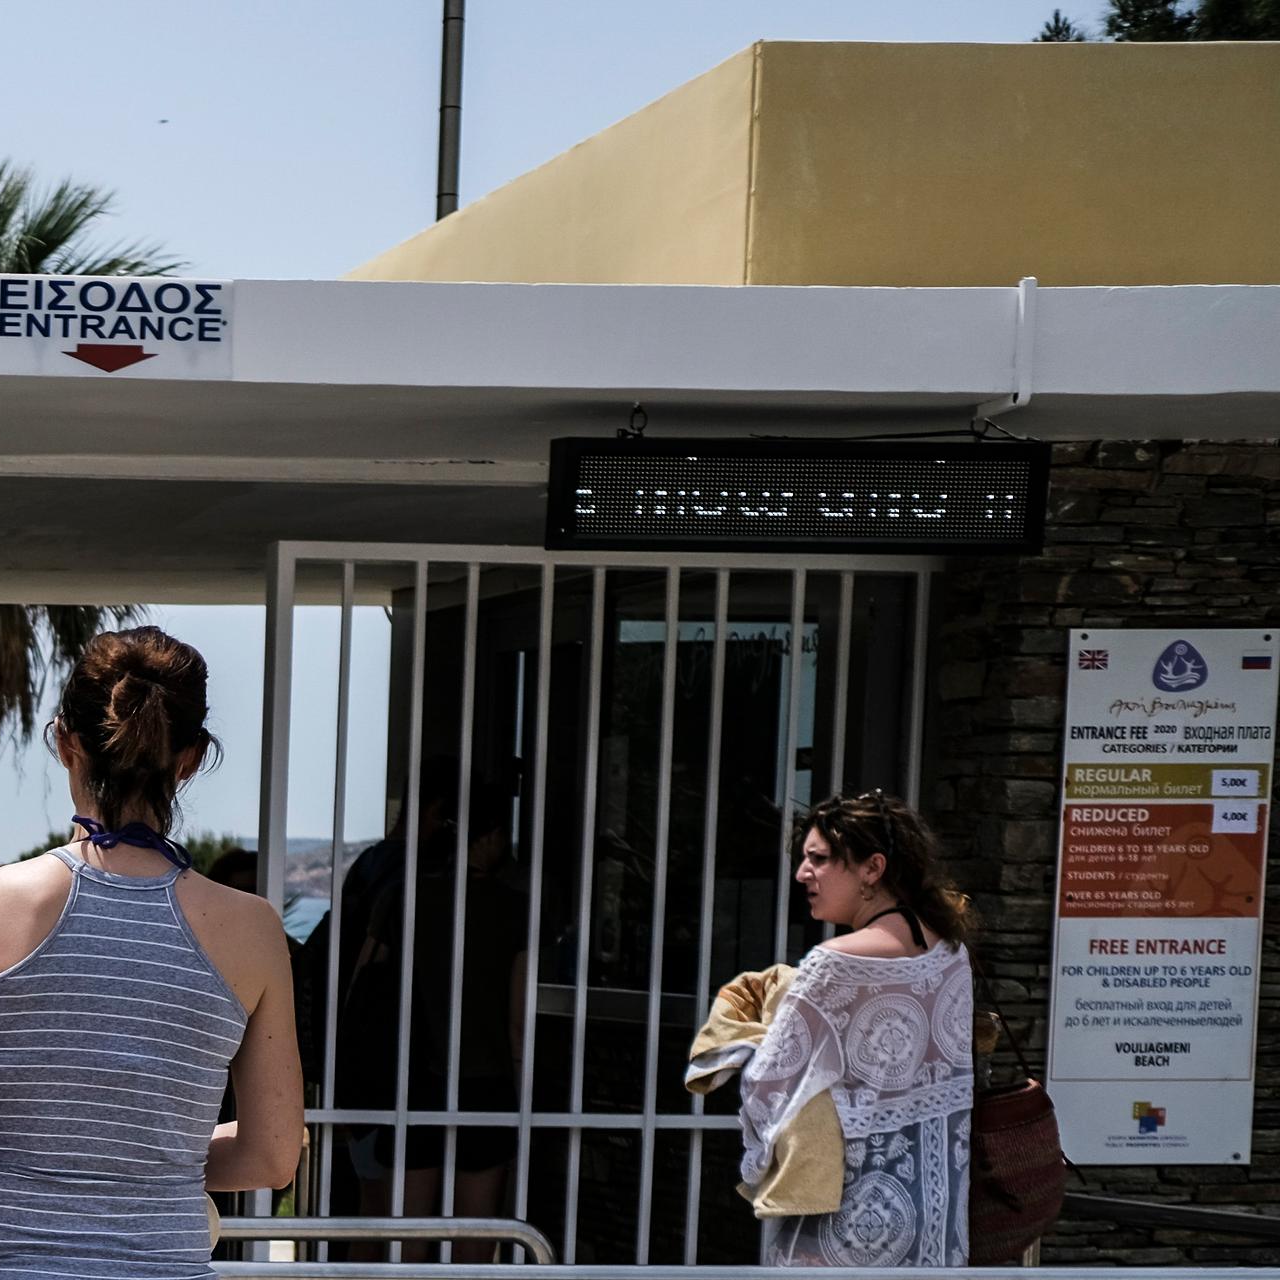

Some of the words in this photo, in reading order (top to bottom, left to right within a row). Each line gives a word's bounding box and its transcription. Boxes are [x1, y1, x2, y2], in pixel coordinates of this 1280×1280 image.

[0, 279, 222, 315] ΕΙΣΟΔΟΣ
[1070, 726, 1126, 740] ENTRANCE
[1130, 726, 1148, 740] FEE
[1154, 725, 1177, 734] 2020
[1102, 744, 1167, 754] CATEGORIES
[1177, 744, 1238, 753] КАТЕГОРИИ
[1074, 768, 1152, 782] REGULAR
[1164, 783, 1203, 795] билет
[1071, 809, 1149, 823] REDUCED
[1132, 823, 1173, 837] билет
[1069, 845, 1114, 853] CHILDREN
[1126, 845, 1139, 853] TO
[1144, 845, 1154, 853] 18
[1156, 845, 1186, 853] YEARS
[1189, 845, 1209, 853] OLD
[1067, 872, 1115, 881] STUDENTS
[1094, 892, 1105, 900] 65
[1109, 892, 1139, 900] YEARS
[1142, 892, 1162, 900] OLD
[1090, 939, 1129, 955] FREE
[1135, 939, 1226, 955] ENTRANCE
[1061, 966, 1083, 976] FOR
[1087, 966, 1140, 976] CHILDREN
[1144, 966, 1159, 976] UP
[1163, 966, 1177, 976] TO
[1180, 966, 1187, 975] 6
[1190, 966, 1226, 976] YEARS
[1229, 966, 1252, 976] OLD
[1101, 978, 1110, 988] &
[1114, 978, 1167, 988] DISABLED
[1170, 978, 1210, 988] PEOPLE
[1147, 1001, 1173, 1013] вход
[1082, 1014, 1089, 1026] 6
[1116, 1042, 1190, 1054] VOULIAGMENI
[1134, 1056, 1170, 1067] BEACH
